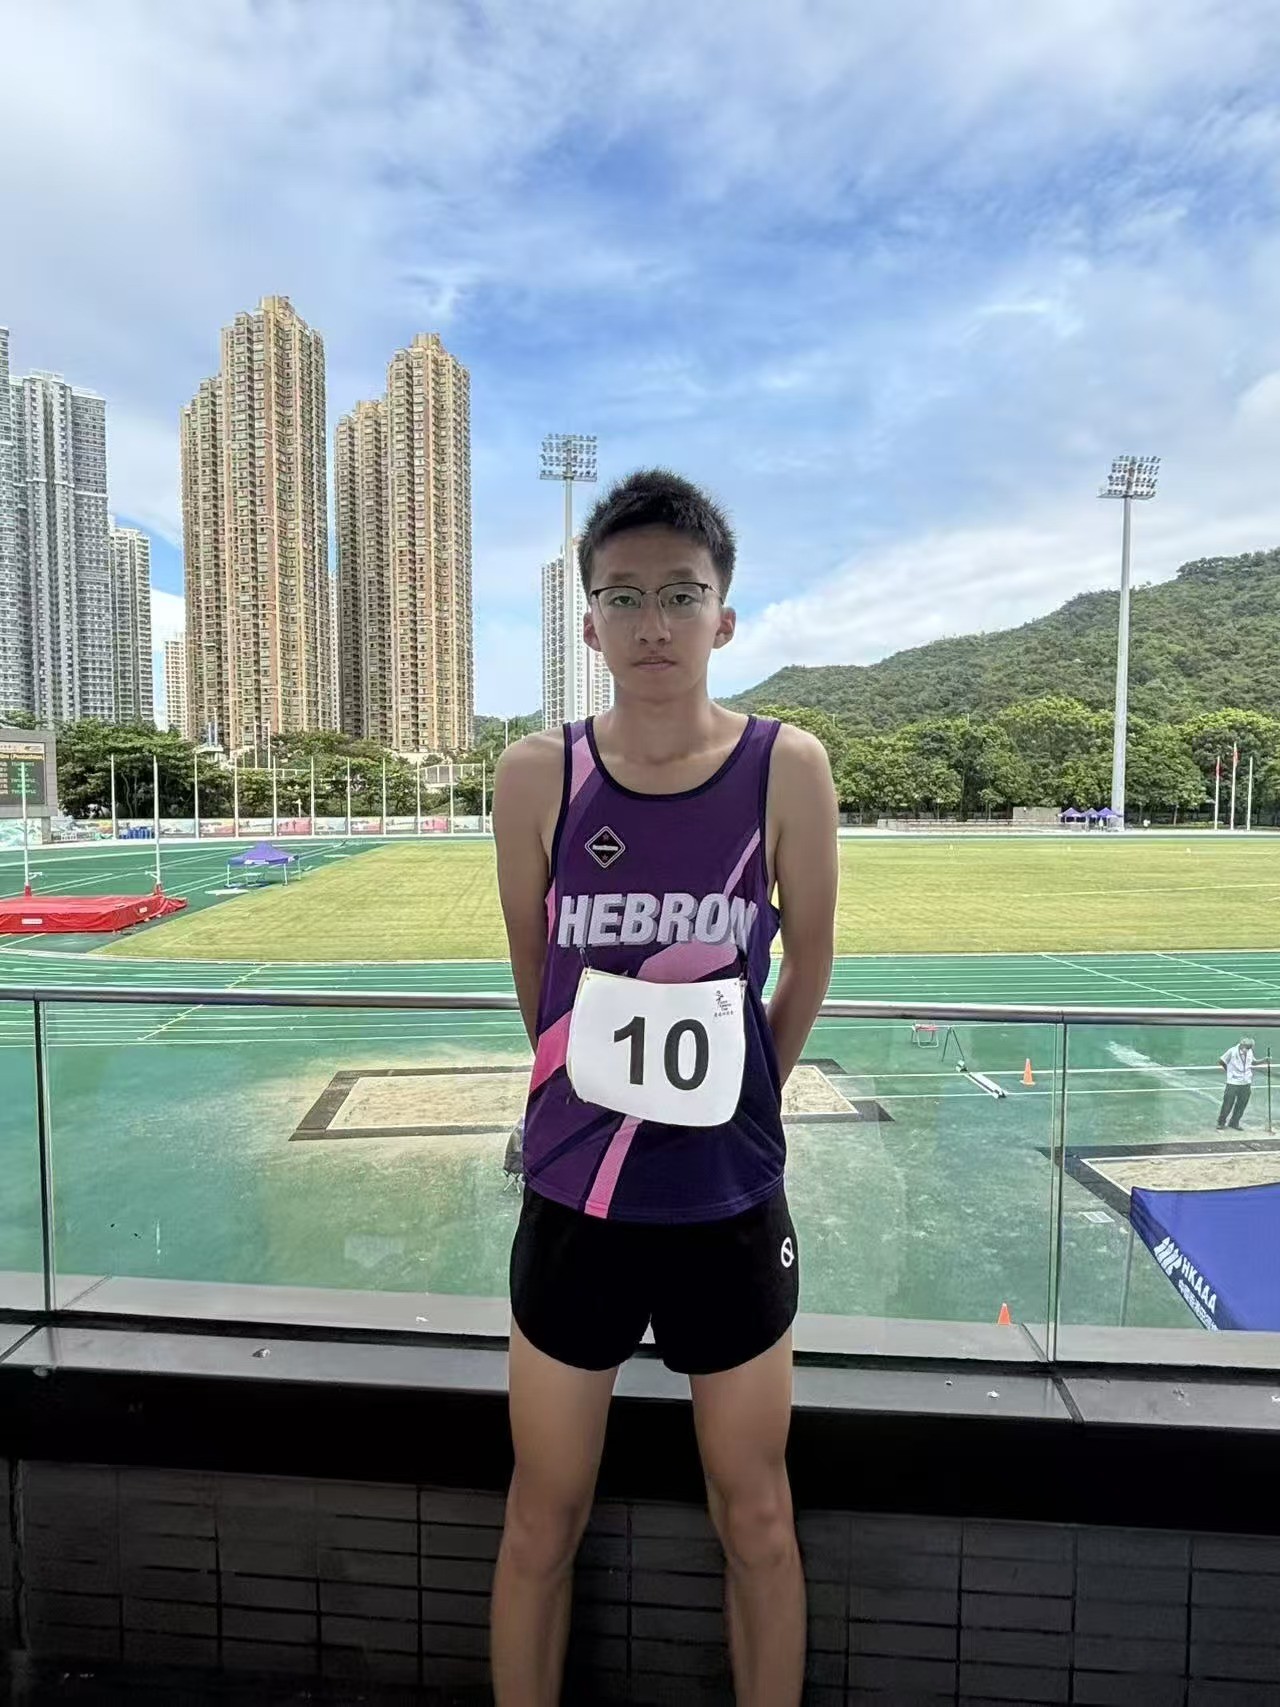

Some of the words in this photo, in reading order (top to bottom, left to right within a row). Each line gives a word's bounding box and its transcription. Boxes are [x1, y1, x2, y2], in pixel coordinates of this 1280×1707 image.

[557, 893, 758, 951] HEBRON
[613, 1016, 709, 1091] 10
[1181, 1256, 1217, 1315] HKAAA
